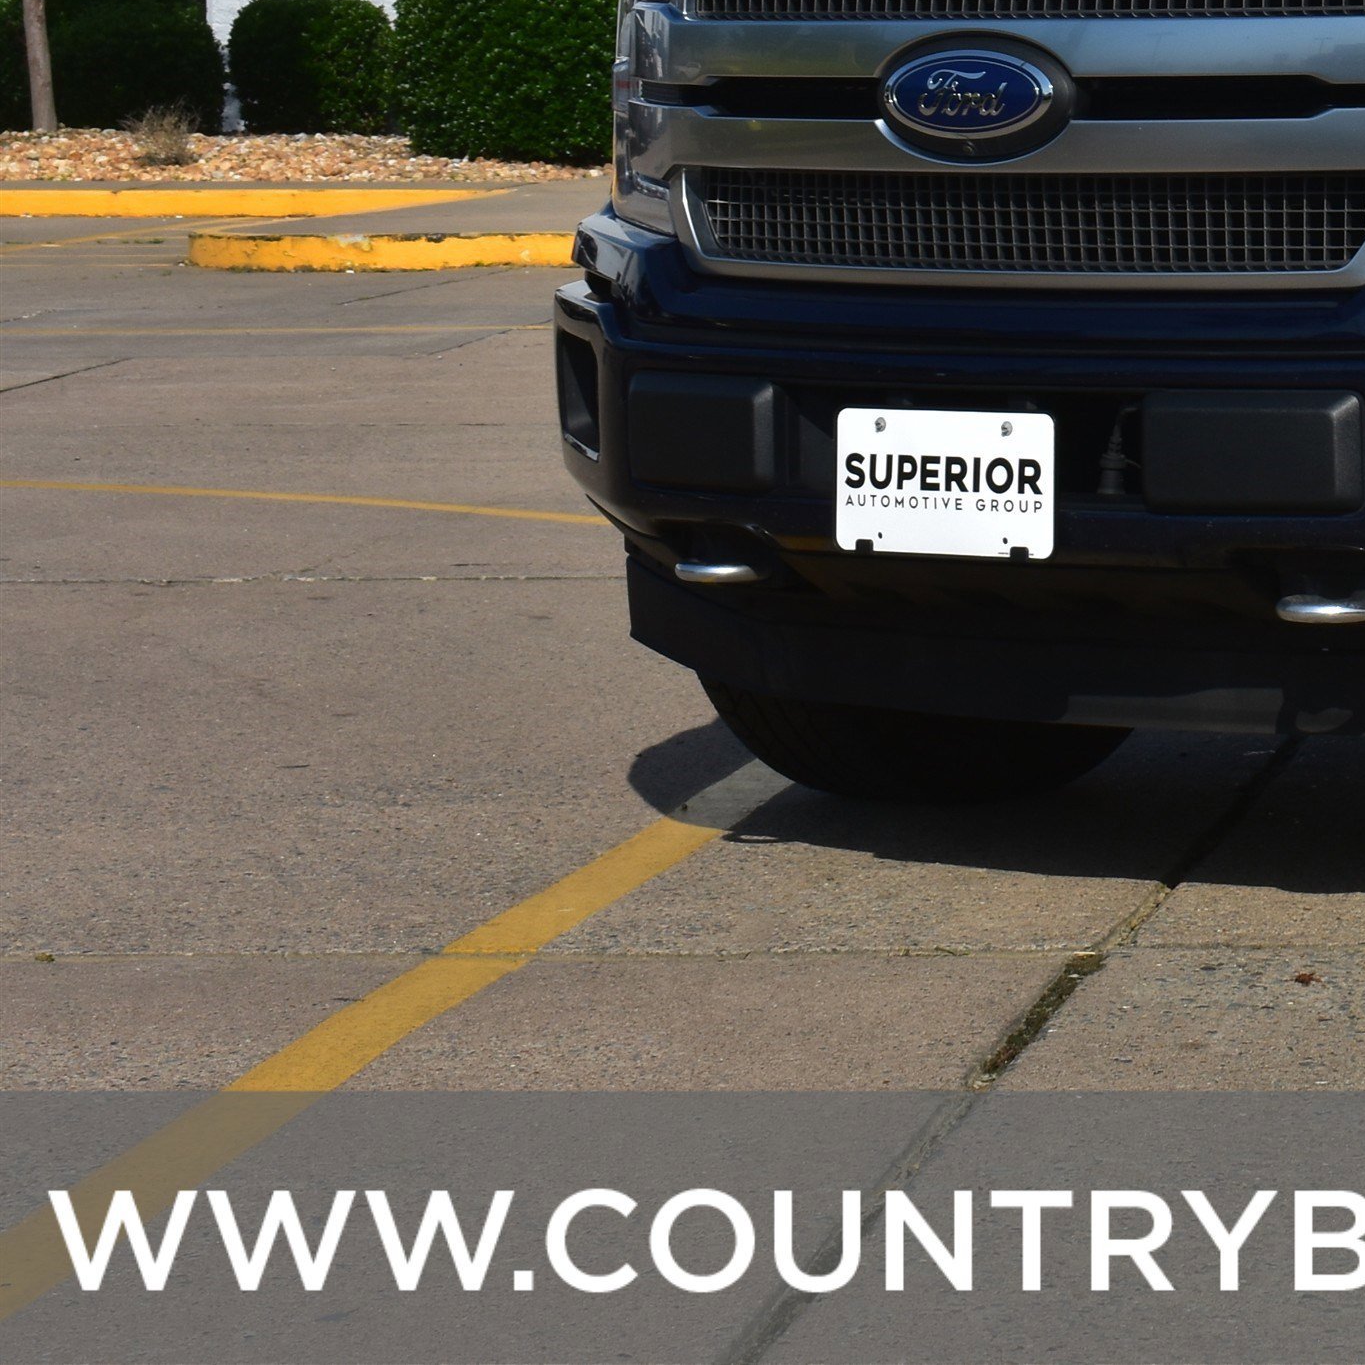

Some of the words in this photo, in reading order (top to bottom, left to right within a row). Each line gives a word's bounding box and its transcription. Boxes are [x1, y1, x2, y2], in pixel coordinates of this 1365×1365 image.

[917, 68, 1008, 117] Ford
[845, 452, 1043, 495] SUPERIOR
[845, 494, 963, 511] AUTOMOTIVE
[975, 498, 1043, 514] GROUP
